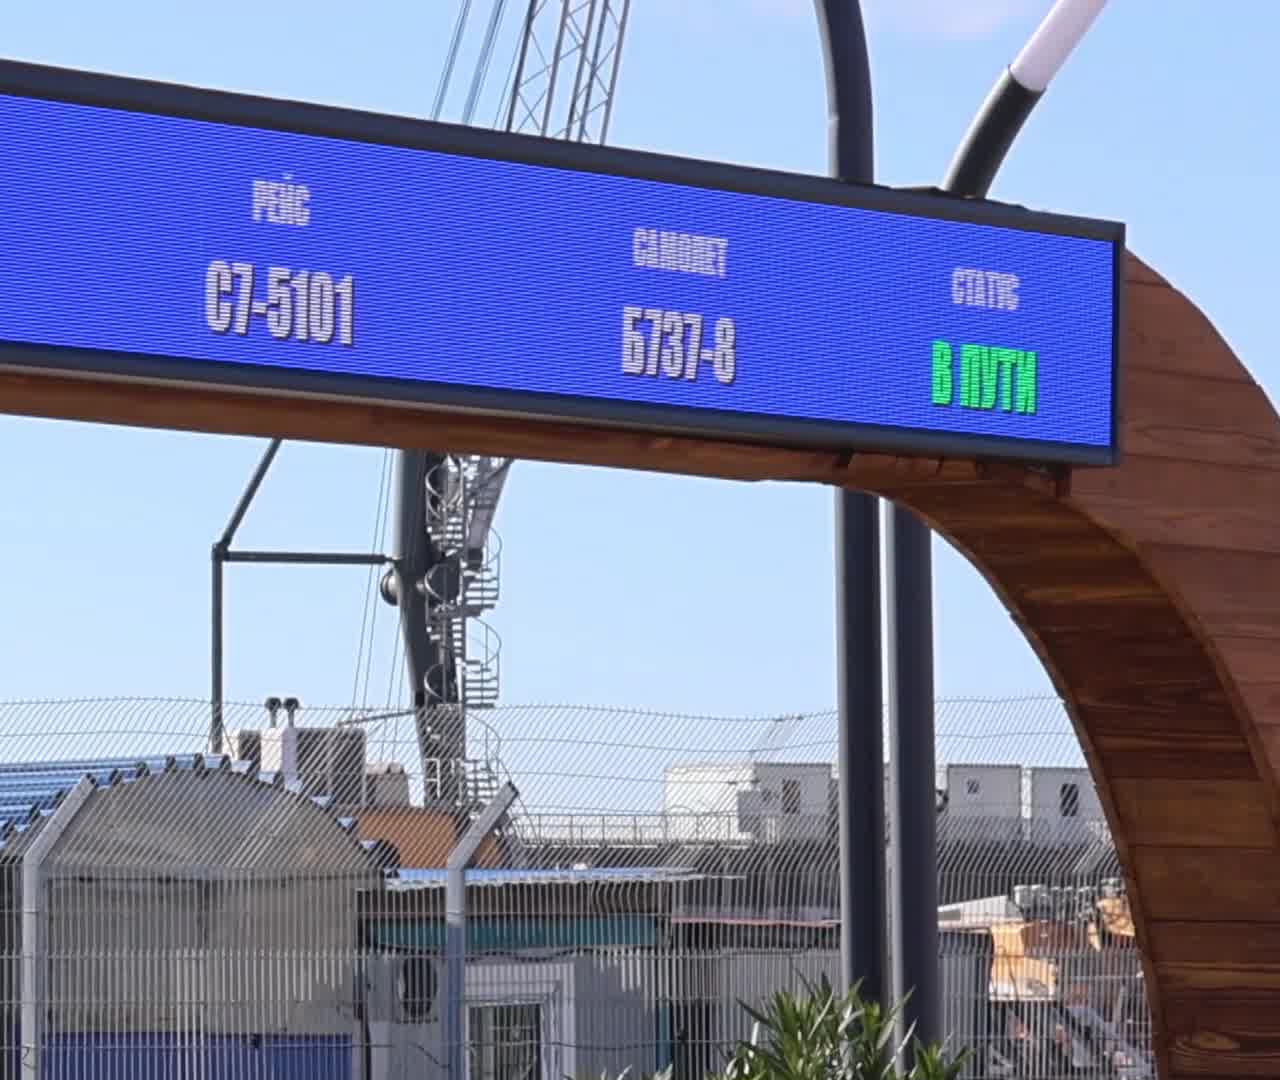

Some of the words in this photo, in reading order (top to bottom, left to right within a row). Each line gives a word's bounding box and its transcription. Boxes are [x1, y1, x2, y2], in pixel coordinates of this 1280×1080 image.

[252, 173, 311, 225] РЕЙС
[206, 260, 354, 345] С7-5101
[952, 268, 1020, 310] СТАТУС
[622, 306, 736, 384] Б737-8
[930, 340, 954, 405] В
[959, 344, 1038, 415] ПУТИ
